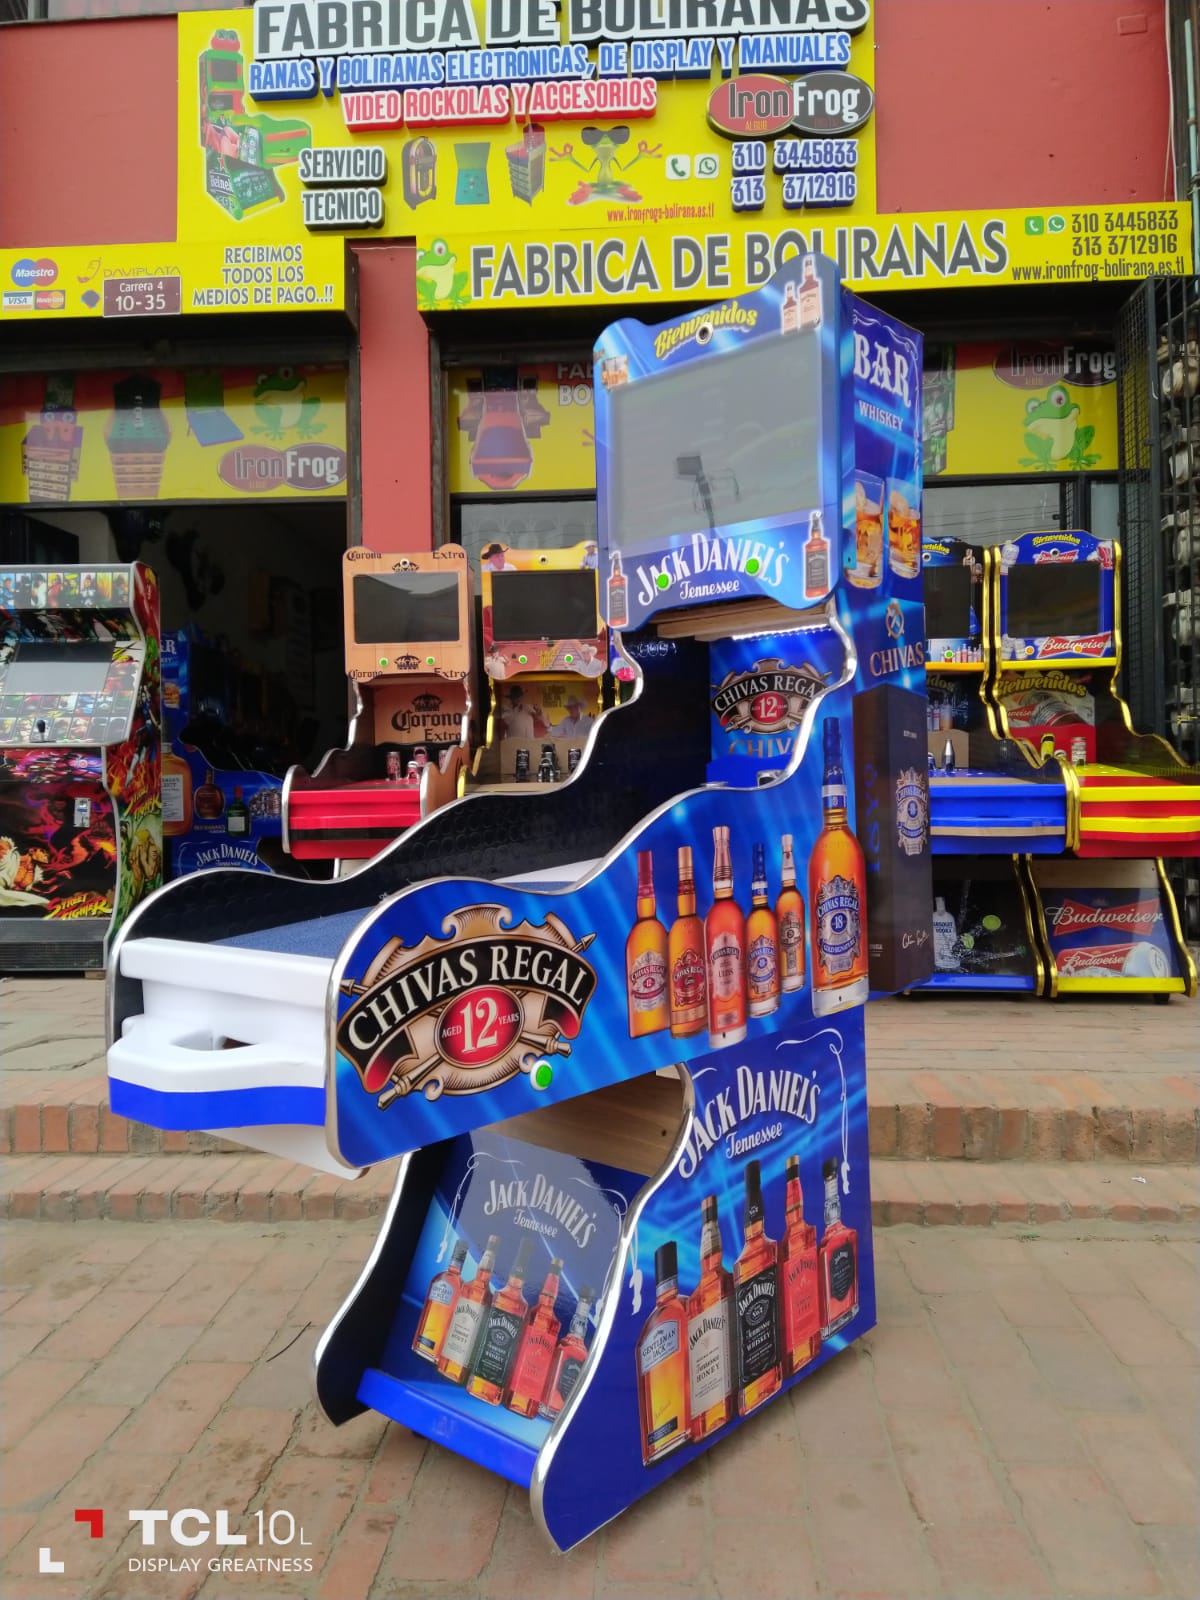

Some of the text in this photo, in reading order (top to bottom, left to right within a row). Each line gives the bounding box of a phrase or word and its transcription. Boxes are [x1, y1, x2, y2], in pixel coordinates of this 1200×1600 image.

[254, 0, 870, 58] FABRICA DE BOLIRANAS
[249, 33, 850, 92] RANAS Y BOLIRANAS ELECTRONICAS, DE DISPLAY Y MANUALES
[342, 78, 657, 124] VIDEO ROCKOLAS Y ACCESORIOS
[299, 147, 385, 182] SERVICIO
[733, 139, 859, 169] 310 3445833
[731, 172, 857, 206] 313 3712916
[302, 188, 384, 225] TECNICO
[1072, 210, 1179, 234] 310 3445833
[224, 245, 303, 264] RECIBIMOS
[1072, 233, 1178, 256] 313 3712916
[15, 267, 55, 279] Maestro
[221, 265, 304, 285] TODOS LOS
[471, 237, 661, 299] FABRICA
[671, 233, 731, 291] DE
[119, 280, 164, 293] Carrera 4
[192, 285, 335, 306] MEDIOS DE PAGO..!!
[115, 294, 166, 312] 10-35
[852, 330, 912, 409] BAR
[858, 400, 904, 432] WHISKEY
[346, 550, 465, 562] Corona Extra
[636, 532, 791, 606] JACK DANIEL'S
[679, 579, 740, 601] Tennessee
[348, 667, 466, 680] Corona Extra
[869, 641, 925, 677] CHIVAS
[714, 675, 820, 712] CHIVAS REGA
[759, 697, 777, 718] 12
[195, 847, 220, 868] JACK
[817, 896, 859, 918] CHIVAS REGAL
[1045, 905, 1164, 926] Budweiser
[834, 915, 844, 930] 18
[348, 945, 590, 1051] CHIVAS REGAL
[441, 996, 520, 1054] AGED 12 YEARS
[678, 1065, 821, 1179] JACK DANIEL'S
[725, 1122, 783, 1159] Tennessee
[483, 1173, 597, 1249] JACK DANIEL'S
[513, 1208, 560, 1239] Tennessee
[738, 1281, 776, 1317] JACK DANIEL'S
[642, 1328, 676, 1357] GENTLEMAN
[652, 1344, 666, 1359] JACK
[689, 1326, 703, 1351] JACK
[746, 1331, 771, 1352] WHISKEY
